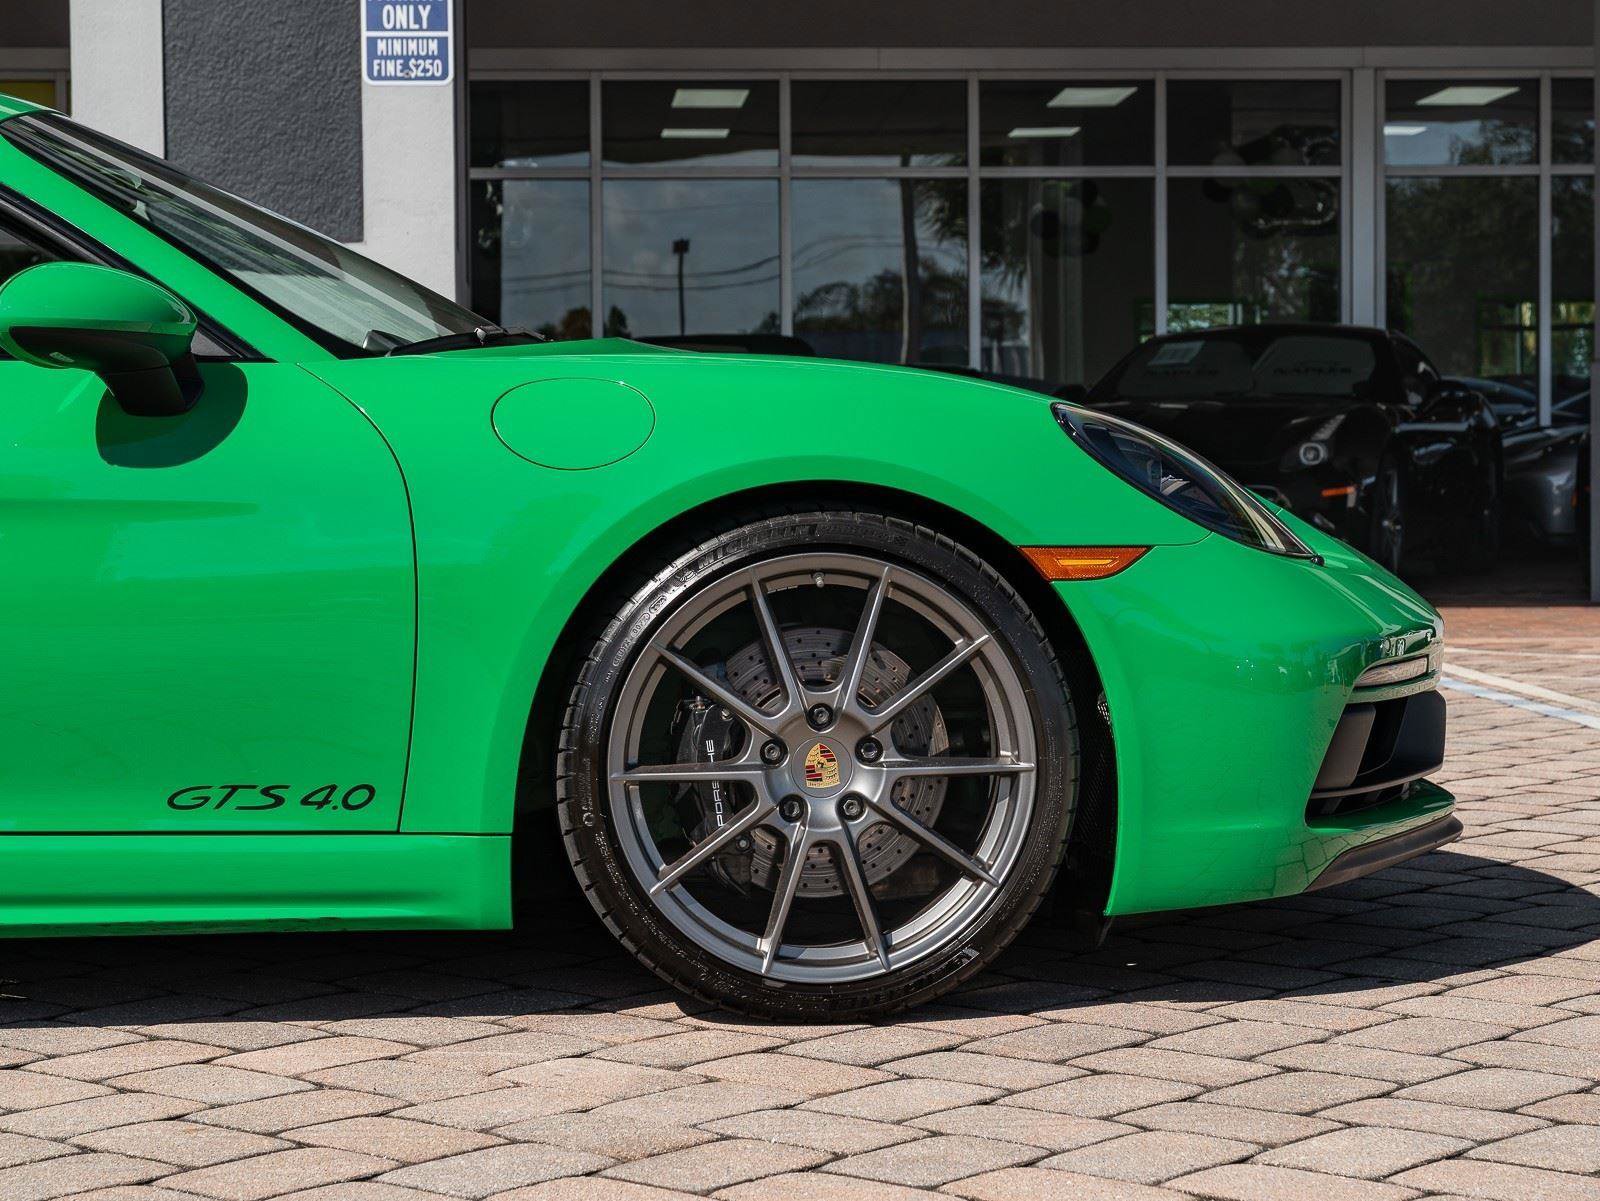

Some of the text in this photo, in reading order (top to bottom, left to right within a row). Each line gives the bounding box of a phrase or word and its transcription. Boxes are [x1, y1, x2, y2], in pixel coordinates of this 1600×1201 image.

[382, 4, 431, 30] ONLY
[376, 38, 438, 56] MINIMUM
[373, 58, 442, 78] FINE $250
[706, 739, 725, 827] PORSHE
[166, 783, 376, 811] GTS 4.0
